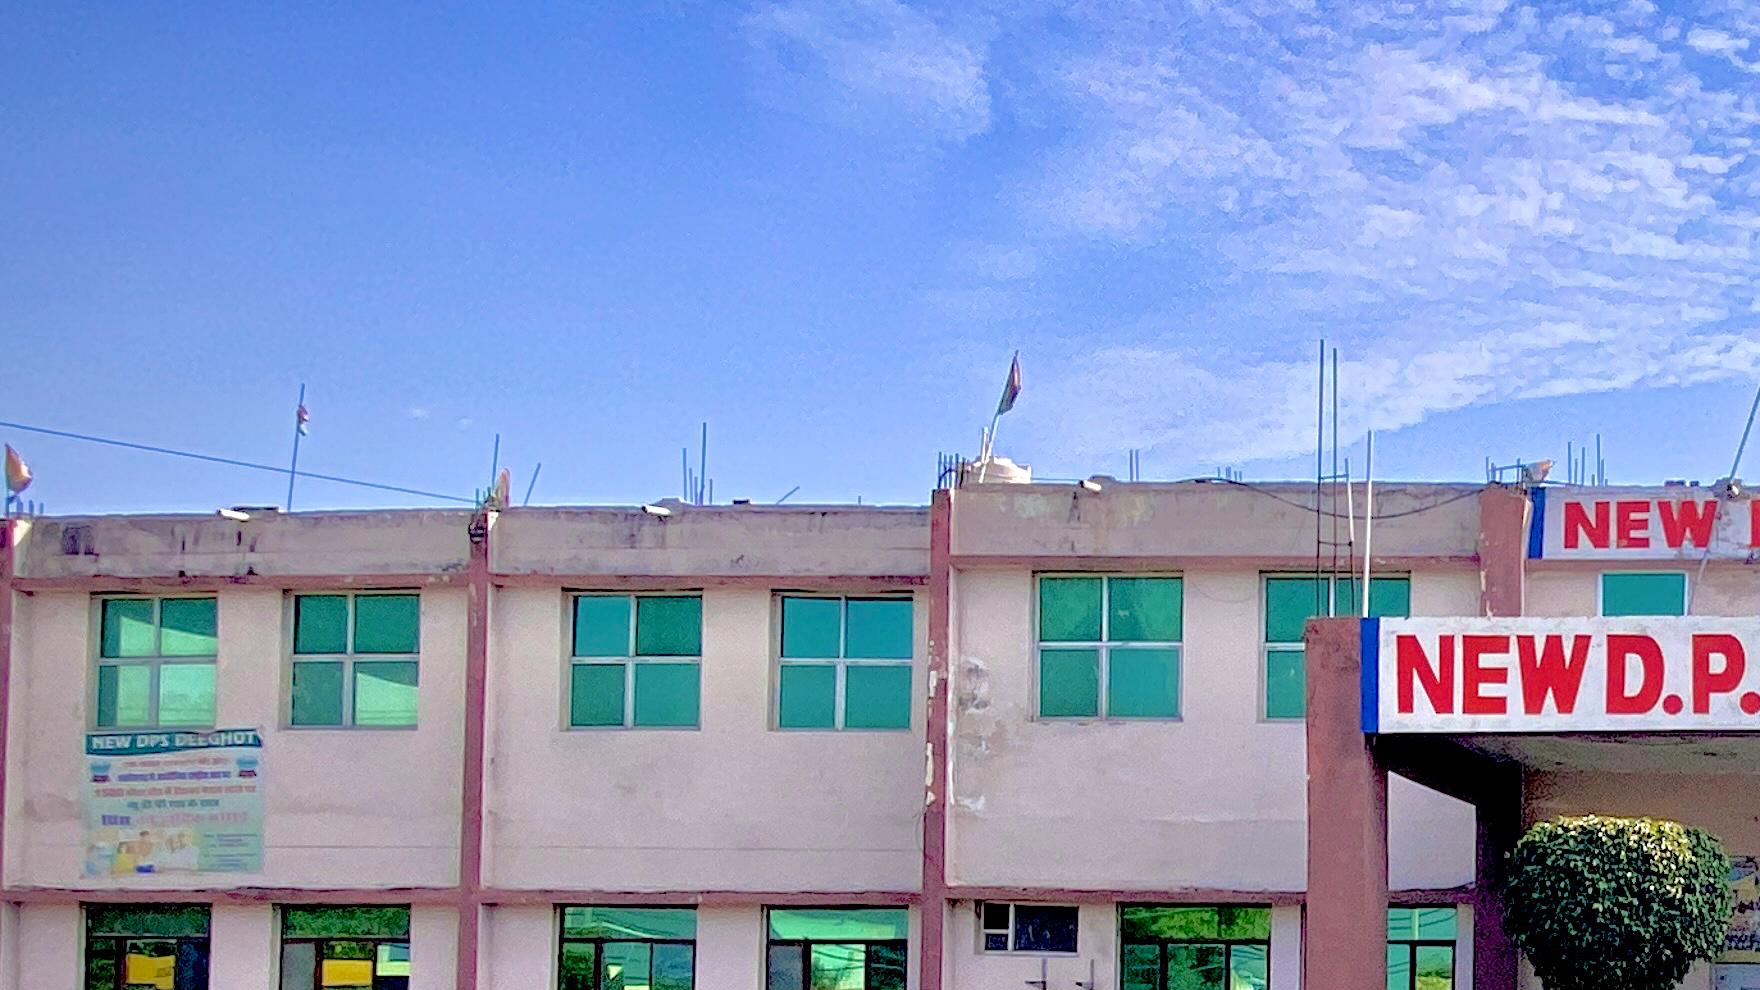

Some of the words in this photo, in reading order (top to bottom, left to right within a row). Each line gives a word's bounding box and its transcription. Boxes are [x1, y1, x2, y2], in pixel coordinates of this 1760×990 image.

[1563, 500, 1717, 550] NEW
[1395, 633, 1592, 715] NEW
[91, 735, 131, 749] NEW
[136, 734, 169, 748] DPS
[175, 732, 256, 746] DEEGHOT
